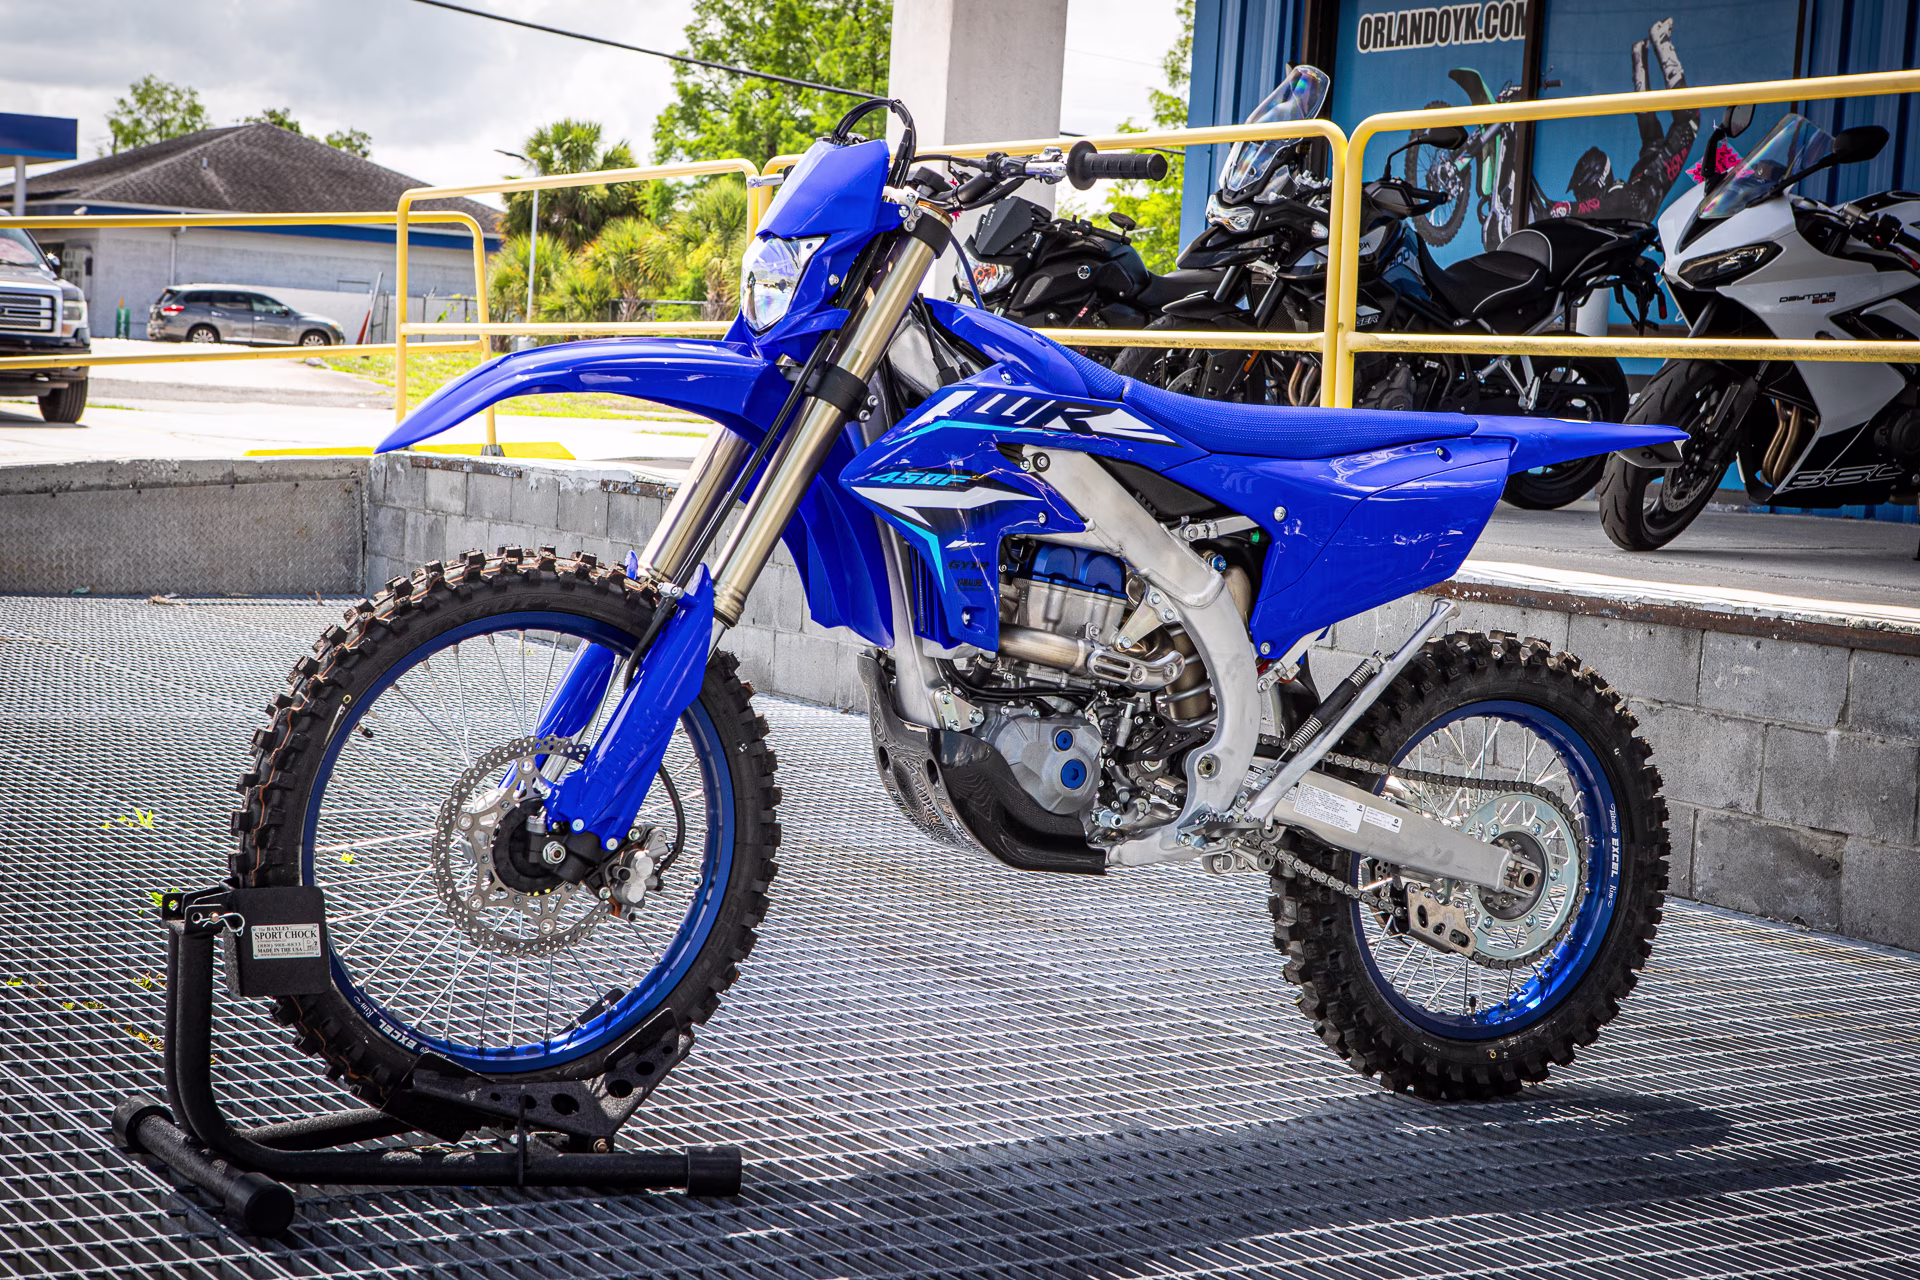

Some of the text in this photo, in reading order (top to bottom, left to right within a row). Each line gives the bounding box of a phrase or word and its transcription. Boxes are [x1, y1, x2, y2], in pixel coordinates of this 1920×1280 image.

[868, 471, 970, 487] 450F
[1611, 838, 1619, 877] EXCEL
[255, 930, 317, 940] SPORT CHOCK
[379, 1018, 418, 1050] EXCEL
